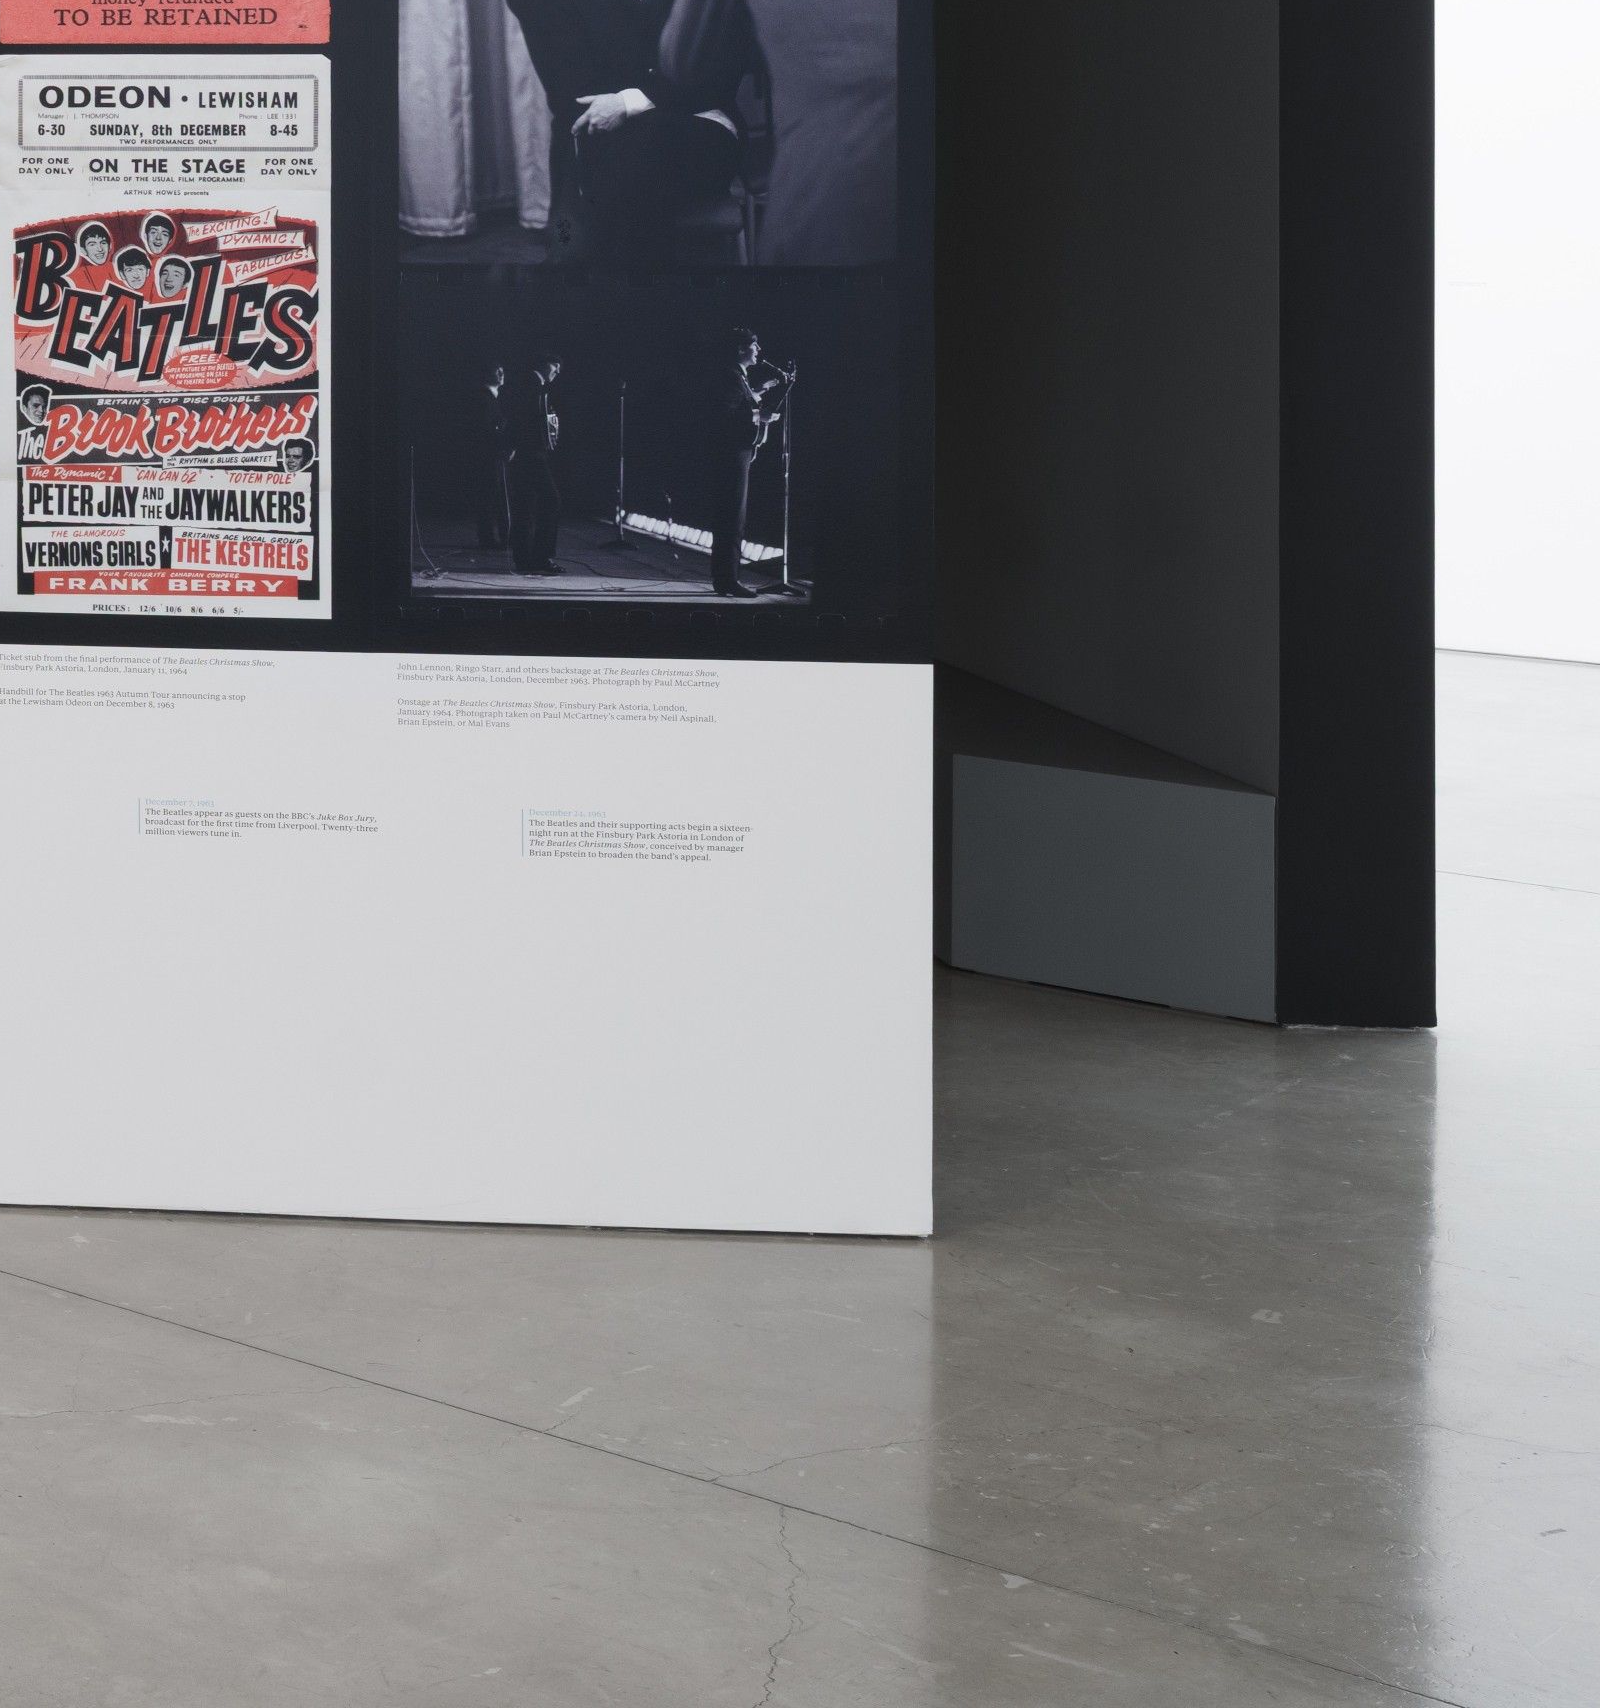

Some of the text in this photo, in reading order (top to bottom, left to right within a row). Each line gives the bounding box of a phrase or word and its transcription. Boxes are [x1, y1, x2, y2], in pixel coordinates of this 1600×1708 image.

[54, 9, 278, 26] TO BE RETAINED
[39, 85, 298, 109] ODEON LEWISHAM
[38, 124, 298, 138] 6-30 SUNDAY, 8th DECEMBER 8-45
[89, 159, 245, 174] ON THE STAGE
[188, 211, 271, 235] The EXCITING!
[223, 232, 297, 245] DYNAMIC!
[235, 248, 309, 275] FABULOUS!
[15, 233, 319, 382] BEATLES
[18, 395, 317, 463] The Brook Brothers
[30, 467, 115, 482] The Dynamic!
[29, 483, 139, 518] PETER JAY
[143, 487, 164, 500] AND
[141, 505, 162, 518] THE
[165, 488, 306, 523] JAYWALKERS
[51, 529, 126, 538] THE GLAMOROUS
[25, 541, 156, 567] VERNONS GIRLS
[175, 538, 309, 570] THE KESTRELS
[50, 577, 284, 592] FRANK BERRY
[145, 828, 175, 836] million
[178, 829, 209, 837] viewers
